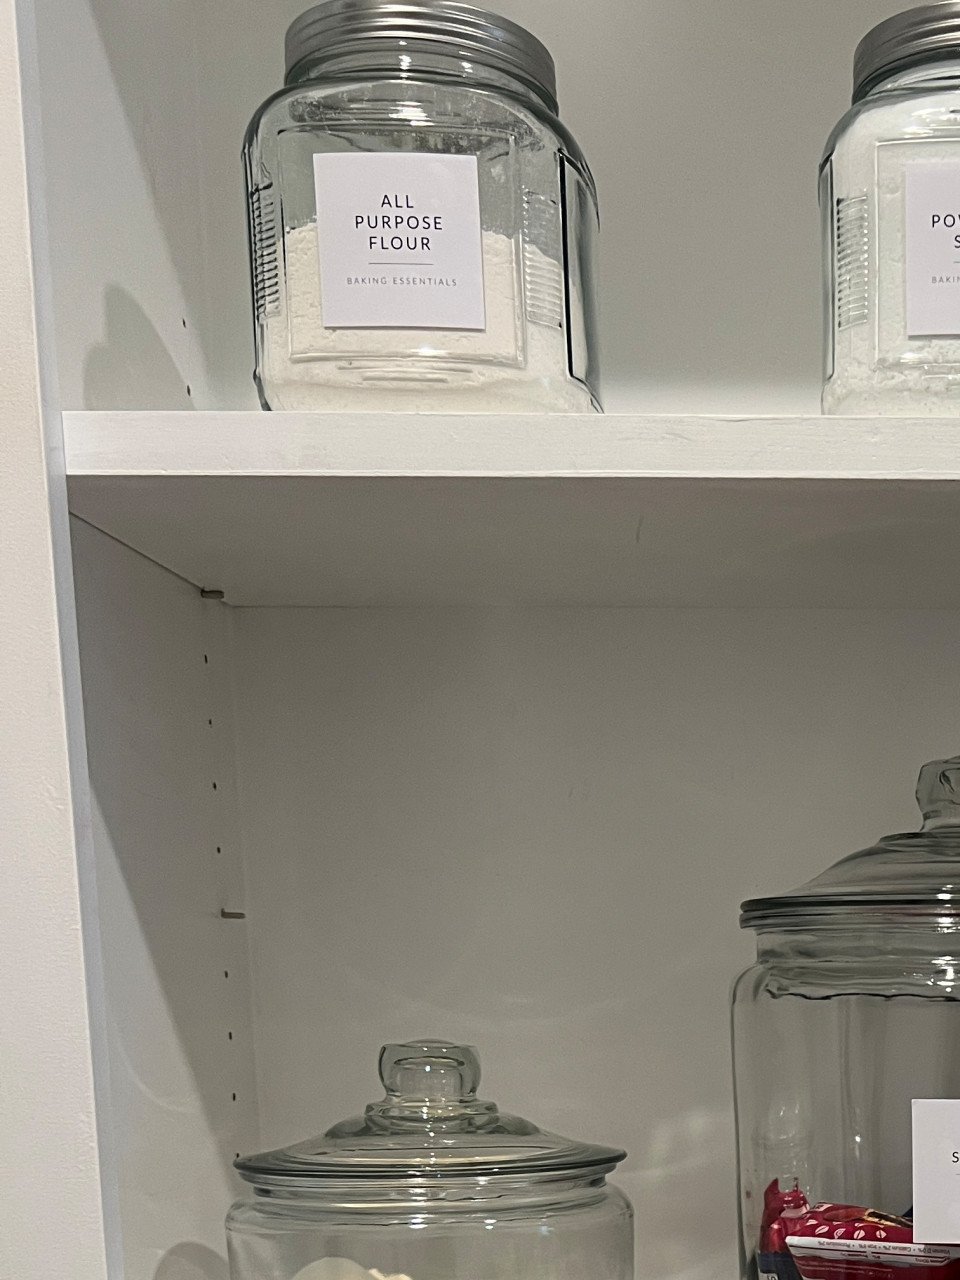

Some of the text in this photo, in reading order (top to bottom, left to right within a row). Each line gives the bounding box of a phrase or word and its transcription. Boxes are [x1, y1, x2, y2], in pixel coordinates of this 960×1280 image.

[380, 194, 415, 209] ALL
[355, 215, 443, 231] PURPOSE
[369, 235, 431, 251] FLOUR
[346, 276, 458, 287] BAKING ESSENTIALS
